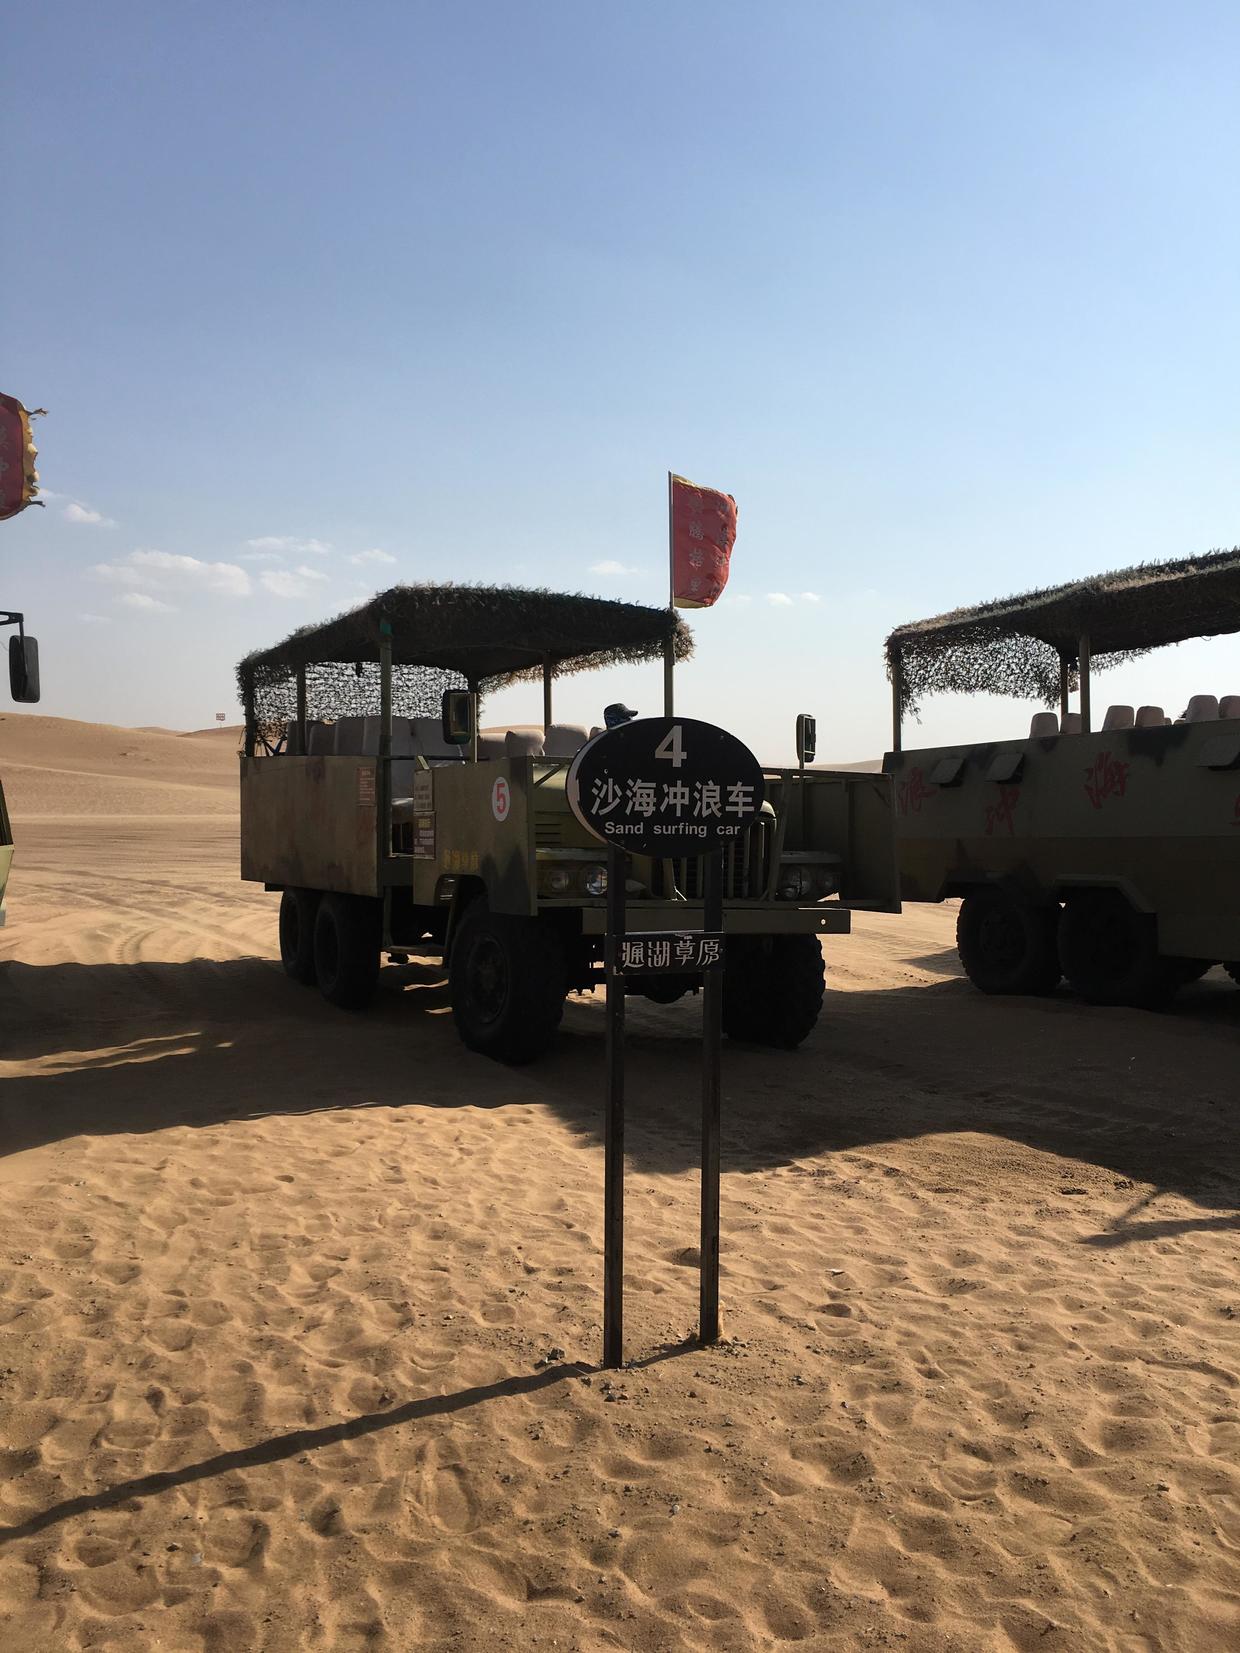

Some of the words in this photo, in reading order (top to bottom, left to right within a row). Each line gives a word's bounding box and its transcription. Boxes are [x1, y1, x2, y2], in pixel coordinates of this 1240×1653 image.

[654, 725, 687, 768] 4
[496, 783, 506, 814] 5
[590, 778, 755, 818] 沙海冲浪车
[604, 821, 644, 835] Sand
[653, 822, 707, 838] surfing
[716, 825, 741, 836] car
[622, 939, 720, 968] 通湖草原
